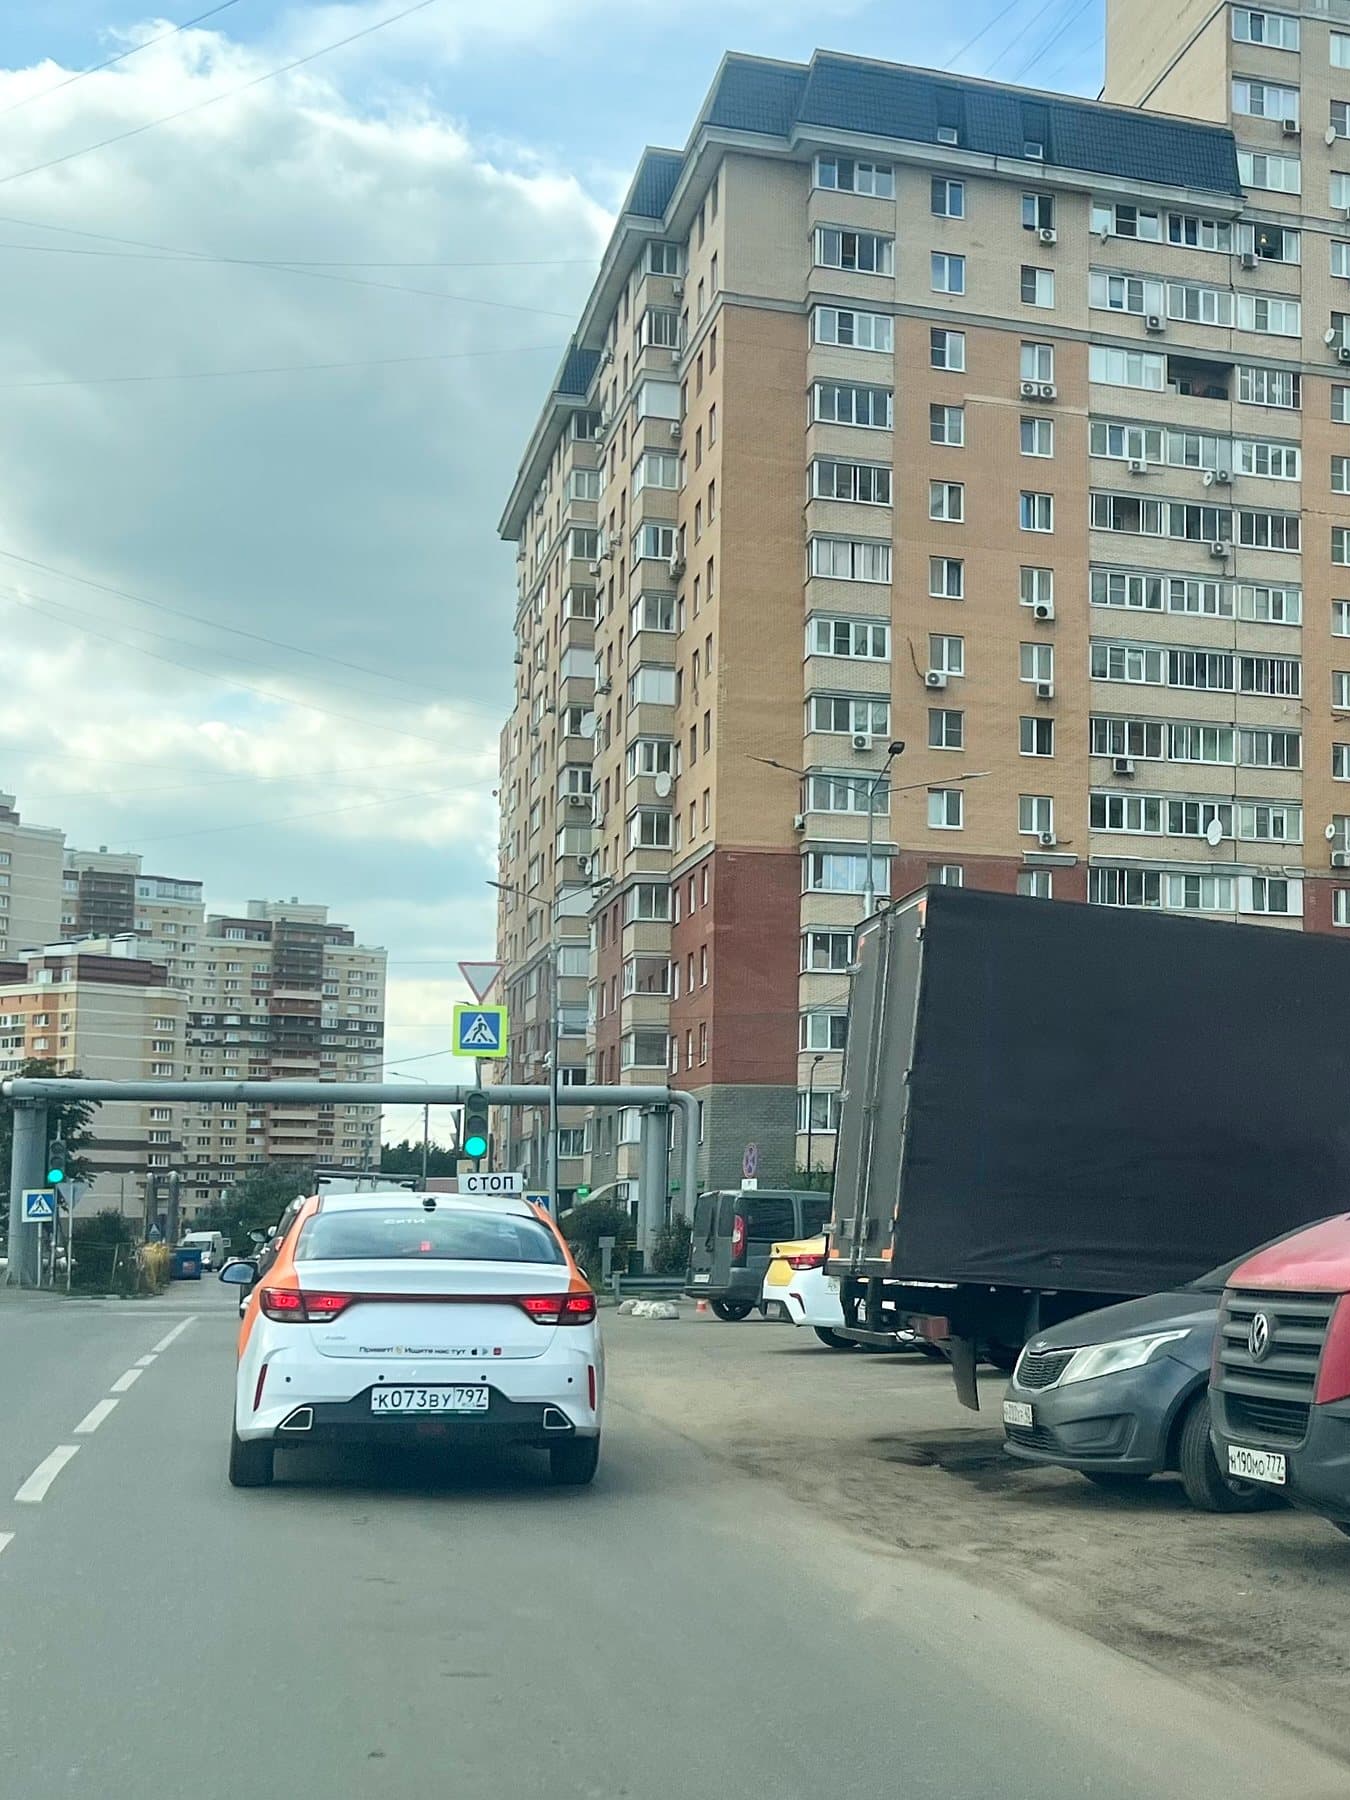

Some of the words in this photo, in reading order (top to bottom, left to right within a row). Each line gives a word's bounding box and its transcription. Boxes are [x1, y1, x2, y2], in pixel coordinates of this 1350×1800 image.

[468, 1176, 514, 1190] СТОП
[456, 1389, 485, 1403] 797
[1266, 1454, 1281, 1472] 777
